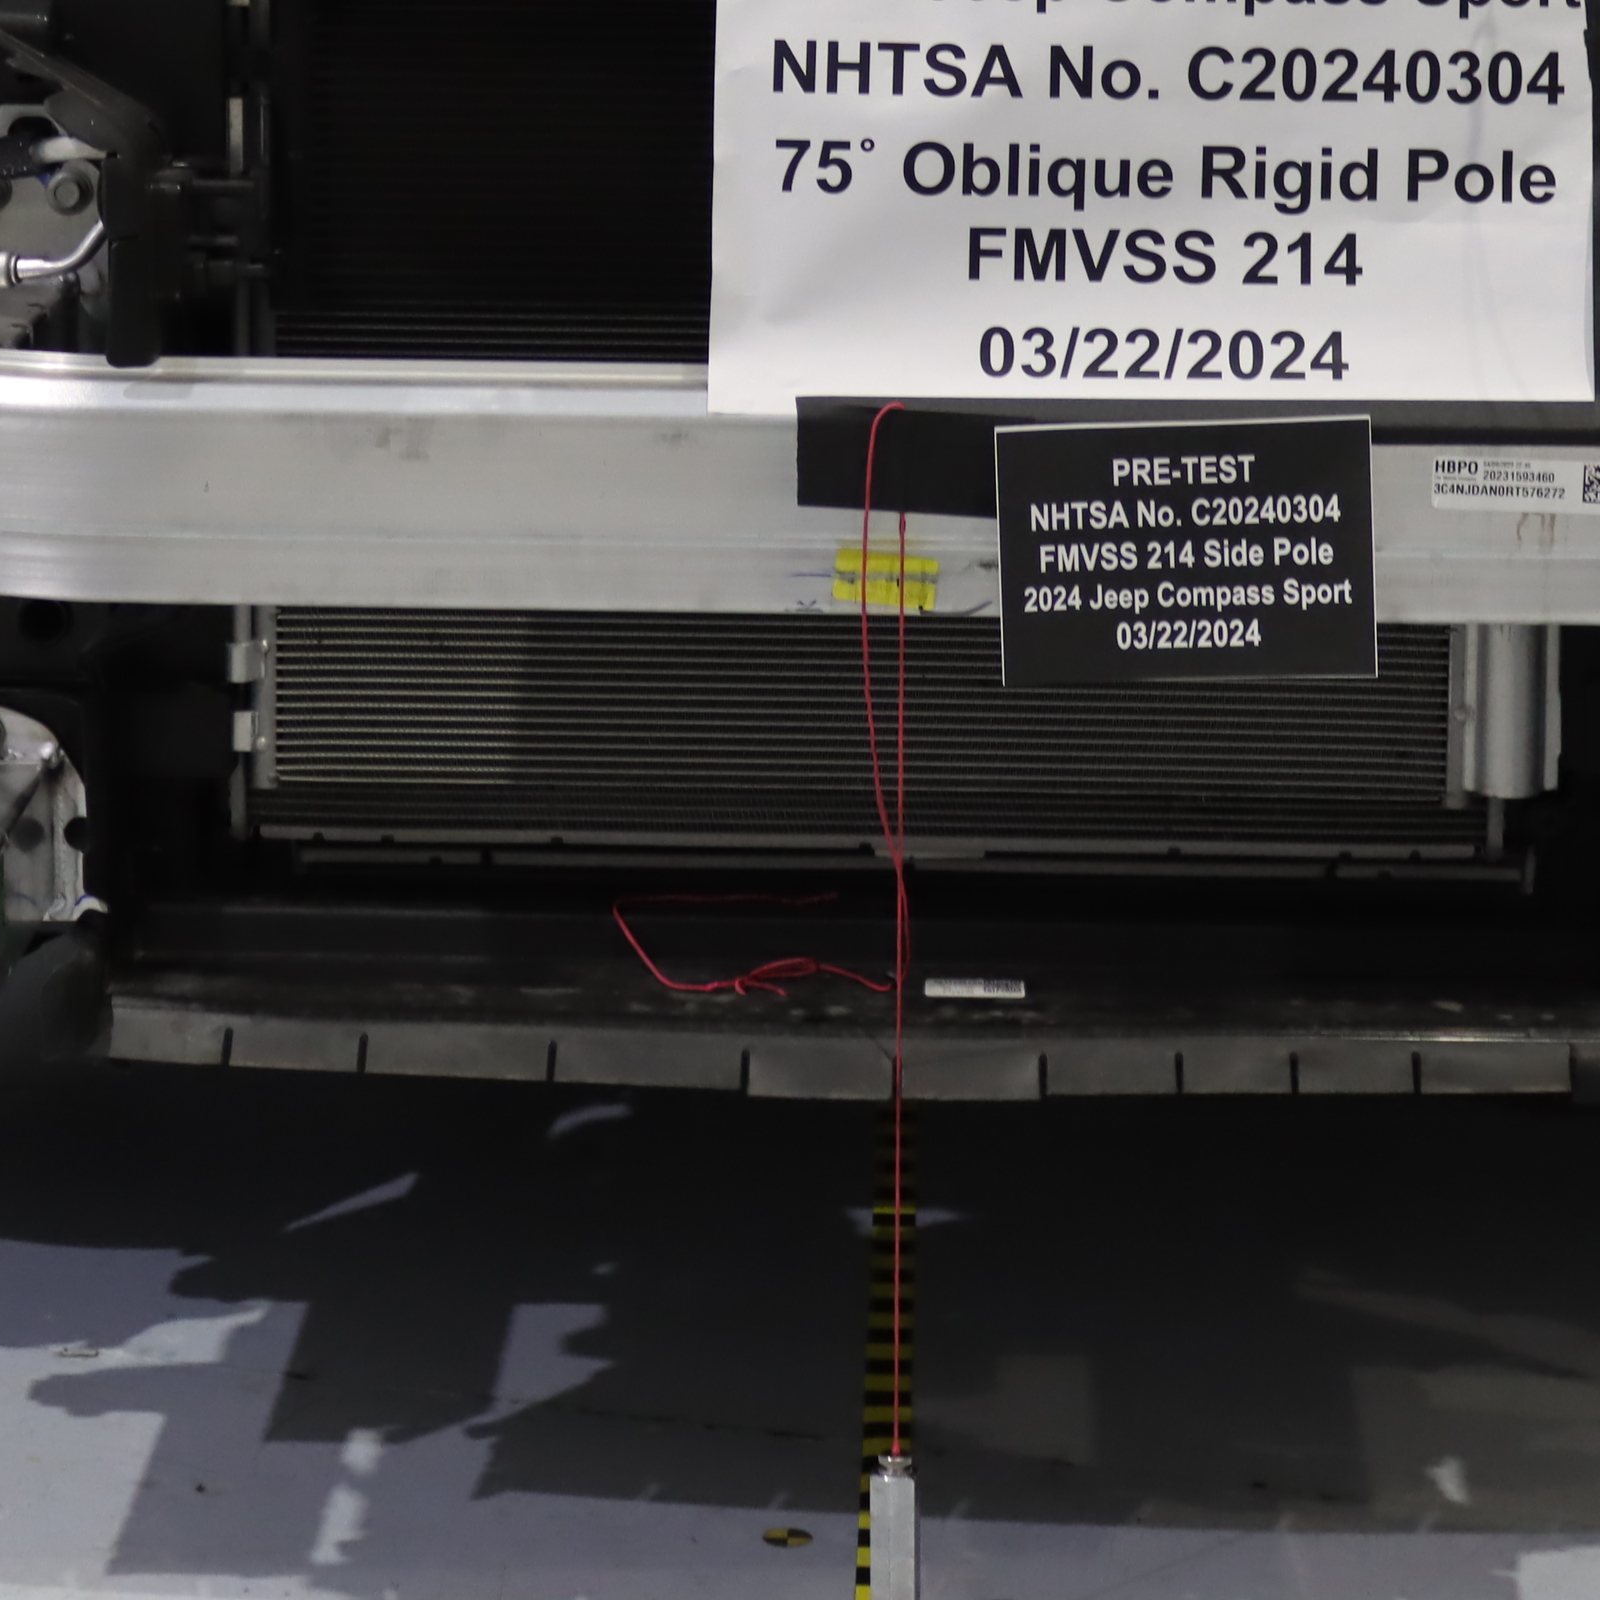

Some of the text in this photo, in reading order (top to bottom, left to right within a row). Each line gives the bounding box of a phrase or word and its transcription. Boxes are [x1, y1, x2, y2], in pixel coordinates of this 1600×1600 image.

[773, 40, 1564, 105] NHTSA No. C20240304
[903, 142, 1173, 211] Oblique
[1202, 146, 1378, 214] Rigid
[1408, 149, 1555, 203] Pole
[969, 228, 1362, 285] FMVSS 214
[980, 327, 1348, 379] 03/22/2024
[1113, 455, 1255, 486] PRE-TEST
[1435, 459, 1479, 475] HBPO
[1483, 470, 1555, 483] 20231593460
[1031, 494, 1341, 531] NHTSA No. C20240304
[1040, 537, 1333, 573] FMVSS 214 Side Pole
[1025, 578, 1352, 614] 2024 Jeep Compass Sport
[1117, 619, 1261, 649] 03/22/2024
